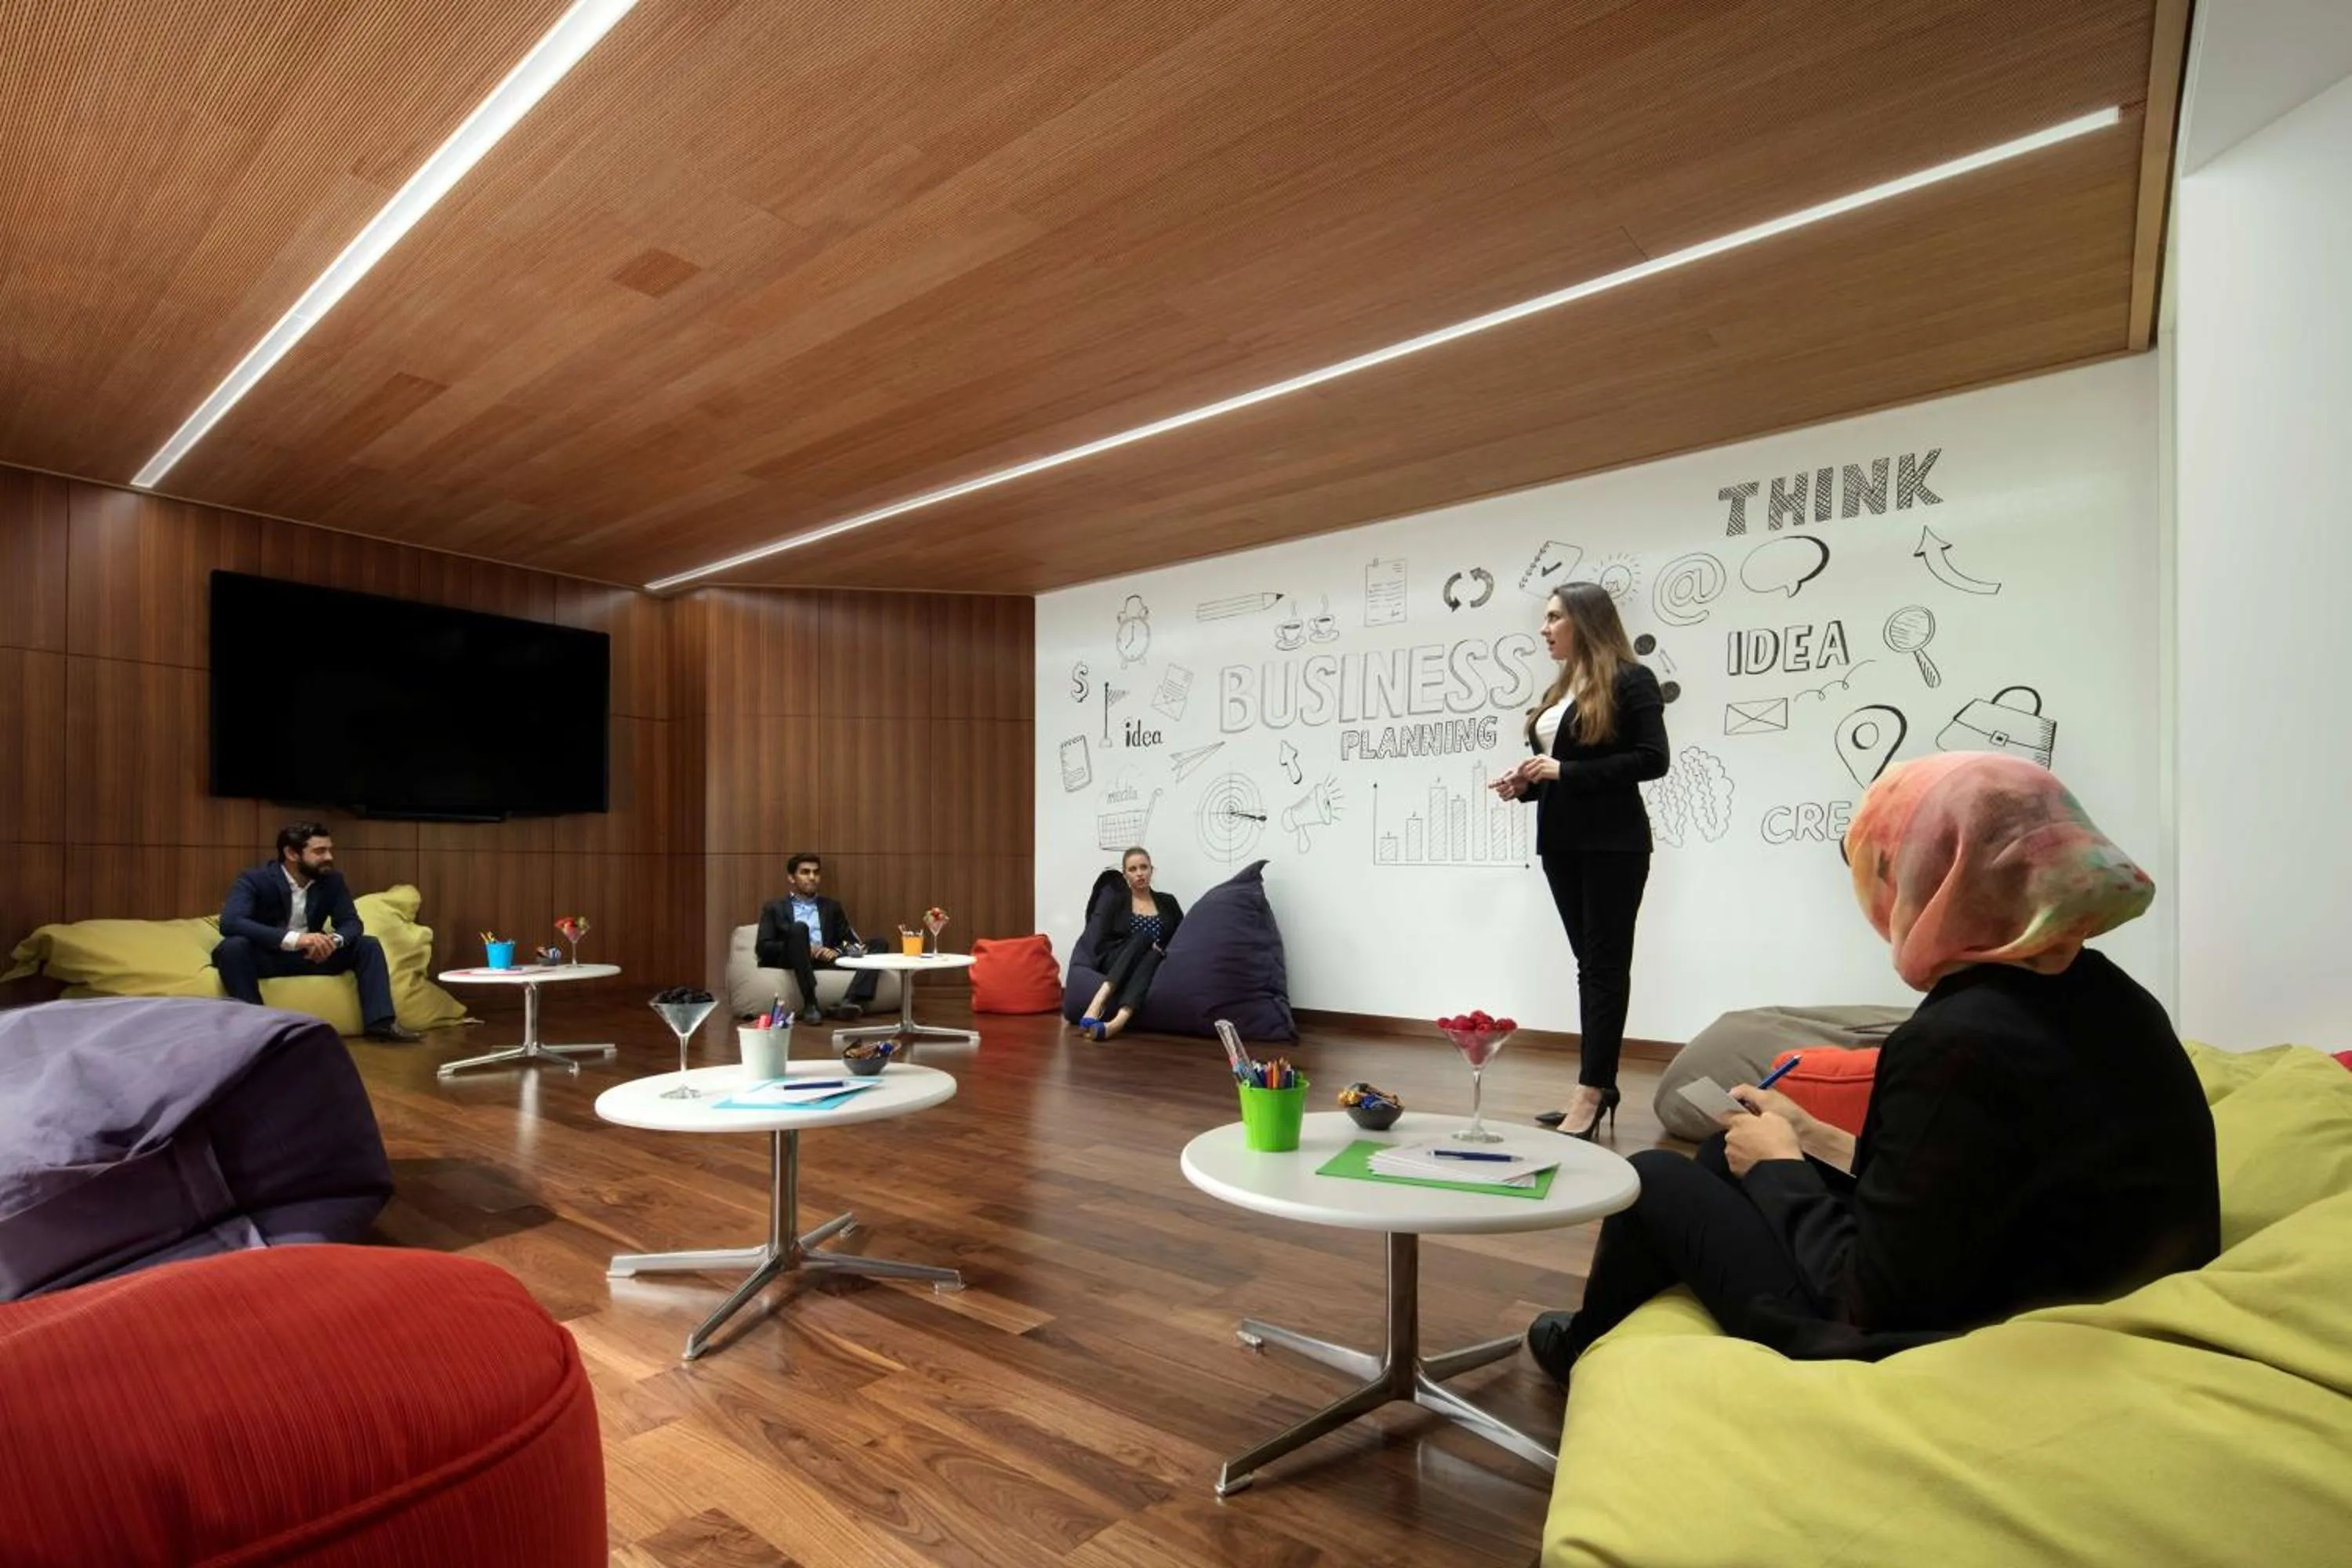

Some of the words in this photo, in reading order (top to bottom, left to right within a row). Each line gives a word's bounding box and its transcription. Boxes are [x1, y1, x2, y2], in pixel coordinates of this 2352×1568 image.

[1719, 448, 1944, 537] THINK
[1726, 620, 1850, 676] IDEA
[1220, 633, 1538, 734] BUSINESS
[1125, 719, 1163, 748] idea
[1341, 715, 1498, 761] PLANNING
